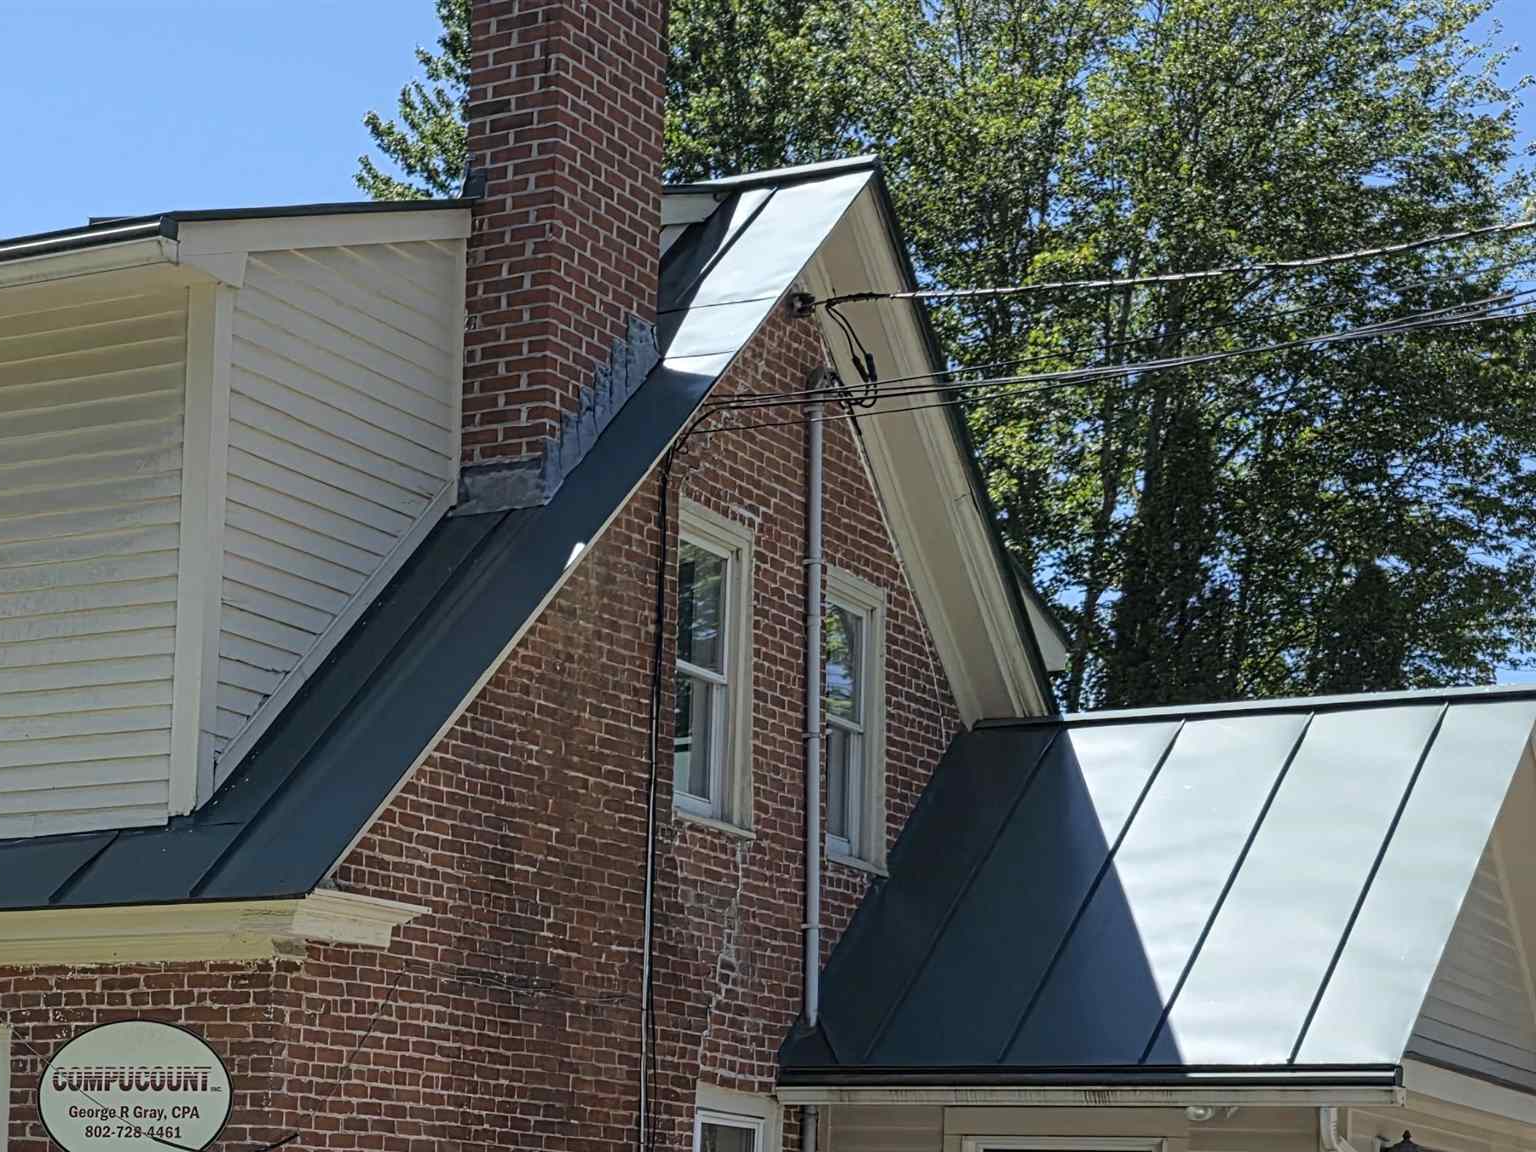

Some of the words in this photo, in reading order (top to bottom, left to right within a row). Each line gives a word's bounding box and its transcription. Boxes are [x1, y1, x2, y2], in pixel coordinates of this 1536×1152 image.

[52, 1066, 212, 1092] COMPUCOUNT
[69, 1106, 116, 1121] George
[121, 1106, 129, 1118] R
[133, 1106, 167, 1121] Gray,
[172, 1106, 200, 1119] CPA
[85, 1126, 182, 1139] 802-728-4461
